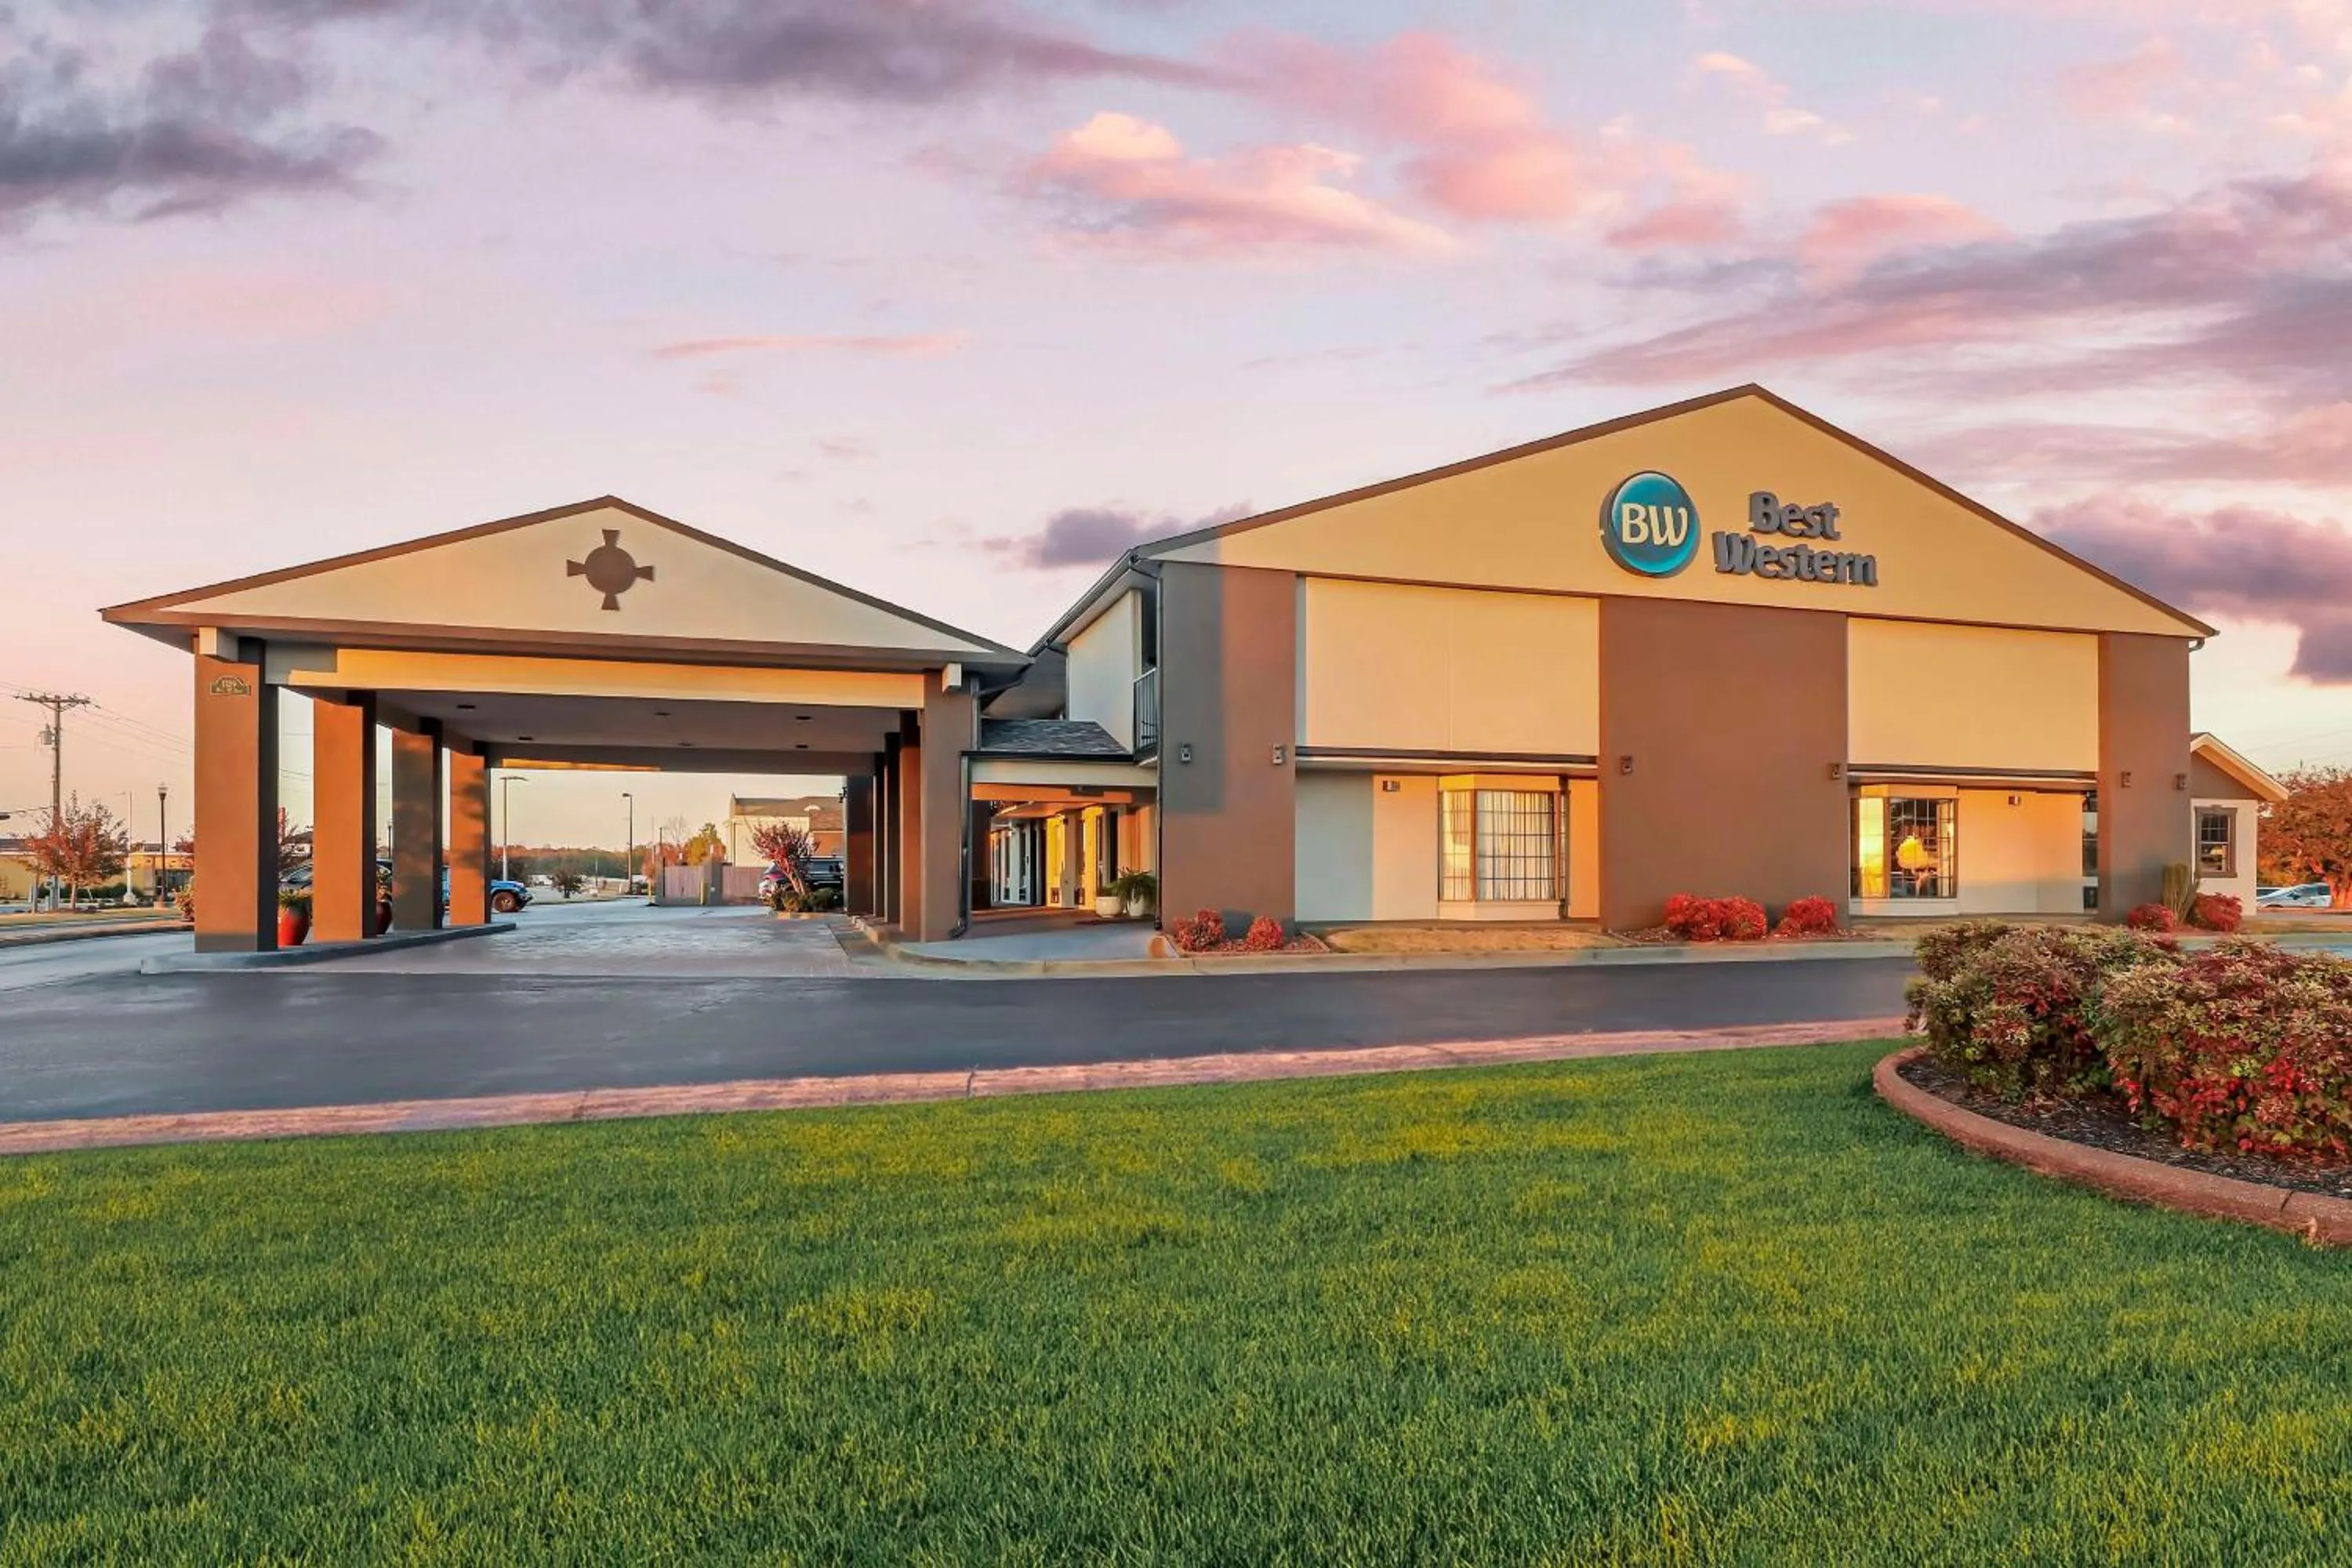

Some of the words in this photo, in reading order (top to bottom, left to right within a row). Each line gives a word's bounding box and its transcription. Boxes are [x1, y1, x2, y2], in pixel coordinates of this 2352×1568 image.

[1621, 503, 1688, 546] BW
[1748, 490, 1841, 540] Best
[1711, 531, 1878, 587] Western
